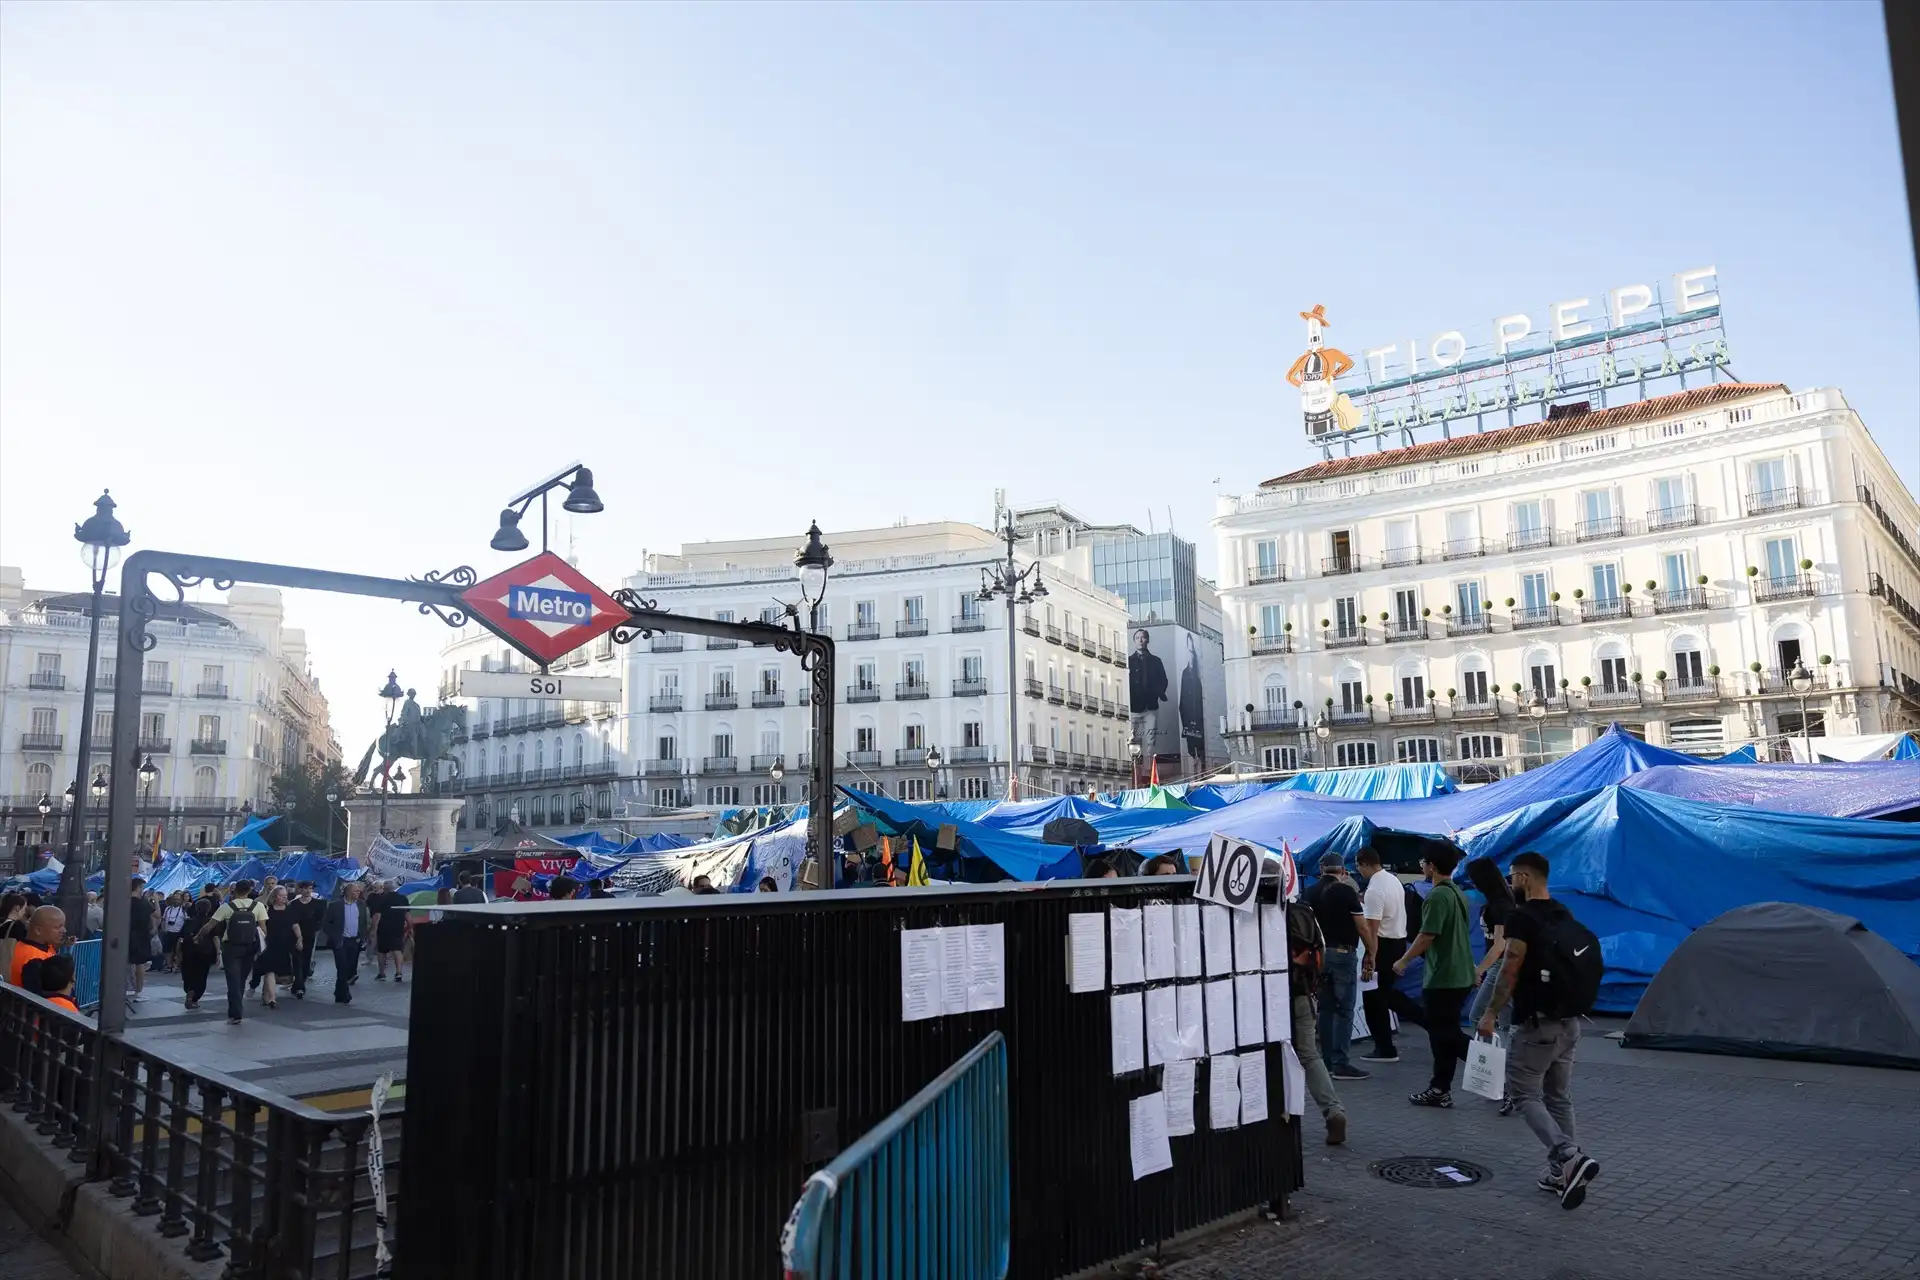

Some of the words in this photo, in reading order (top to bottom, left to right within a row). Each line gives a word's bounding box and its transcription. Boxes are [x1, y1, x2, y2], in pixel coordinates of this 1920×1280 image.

[1363, 330, 1466, 383] TIO
[1493, 264, 1721, 357] PEPE
[1599, 339, 1730, 388] BYASS
[516, 590, 587, 619] Metro
[530, 678, 562, 695] Sol
[380, 826, 422, 841] TOURIST
[540, 858, 573, 871] VIVE
[1196, 838, 1258, 906] NO
